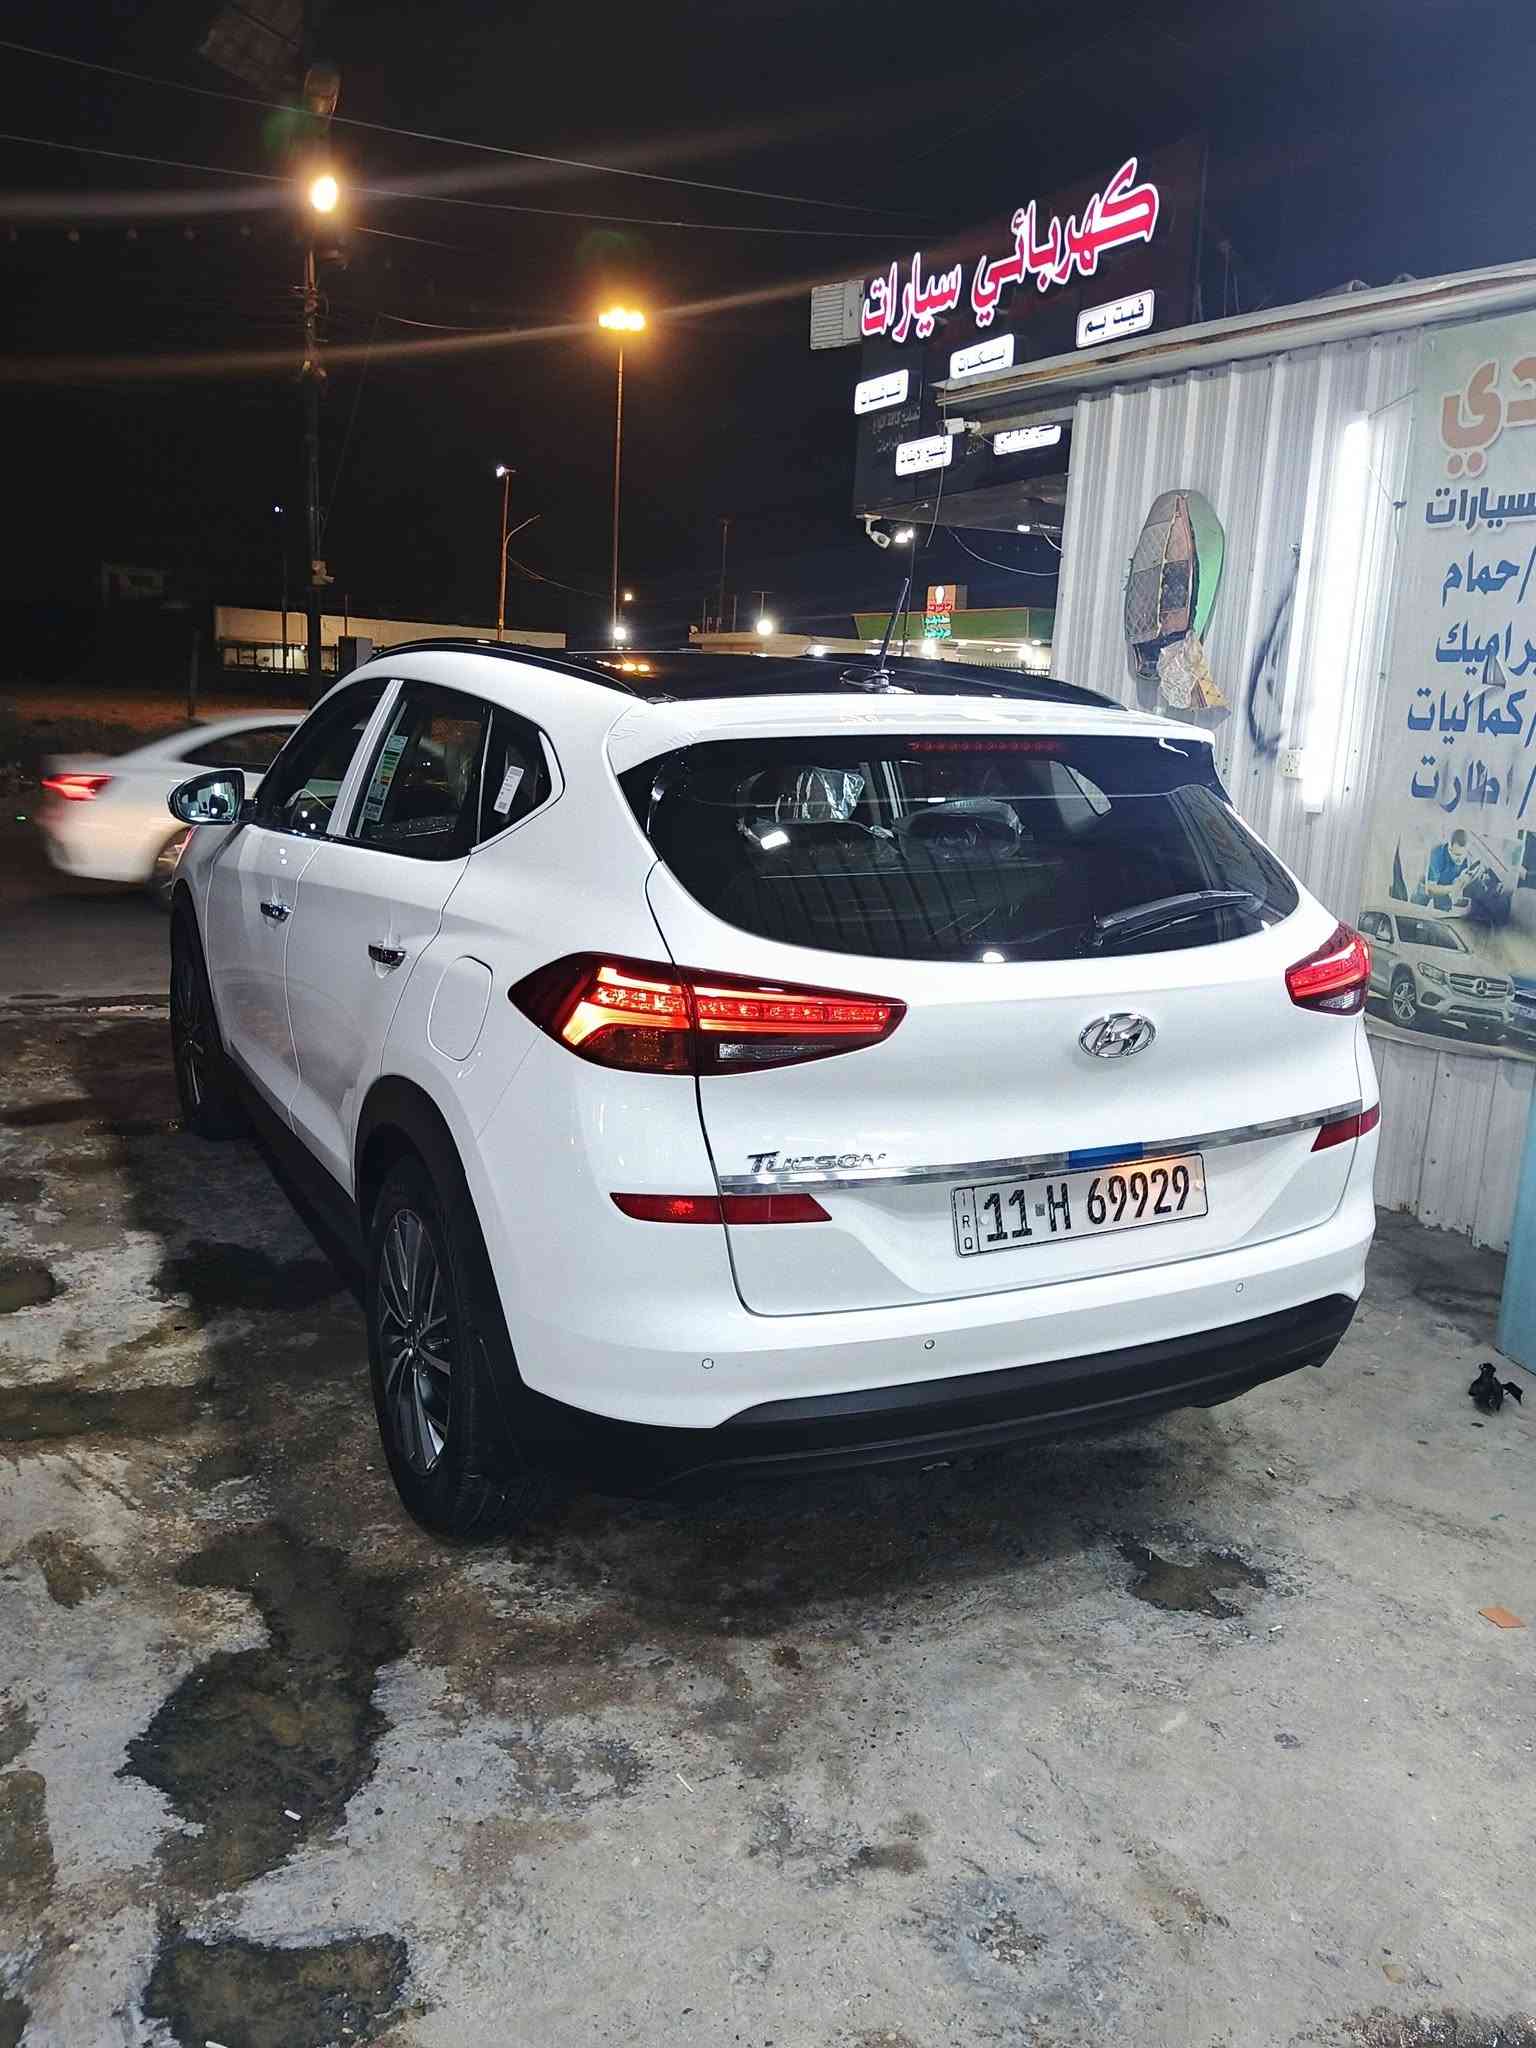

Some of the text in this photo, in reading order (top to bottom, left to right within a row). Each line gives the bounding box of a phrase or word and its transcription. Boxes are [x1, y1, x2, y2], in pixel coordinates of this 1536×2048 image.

[862, 157, 1159, 343] كهربائي سيارات
[1085, 299, 1144, 336] فيت بم
[1087, 1164, 1190, 1226] 69929
